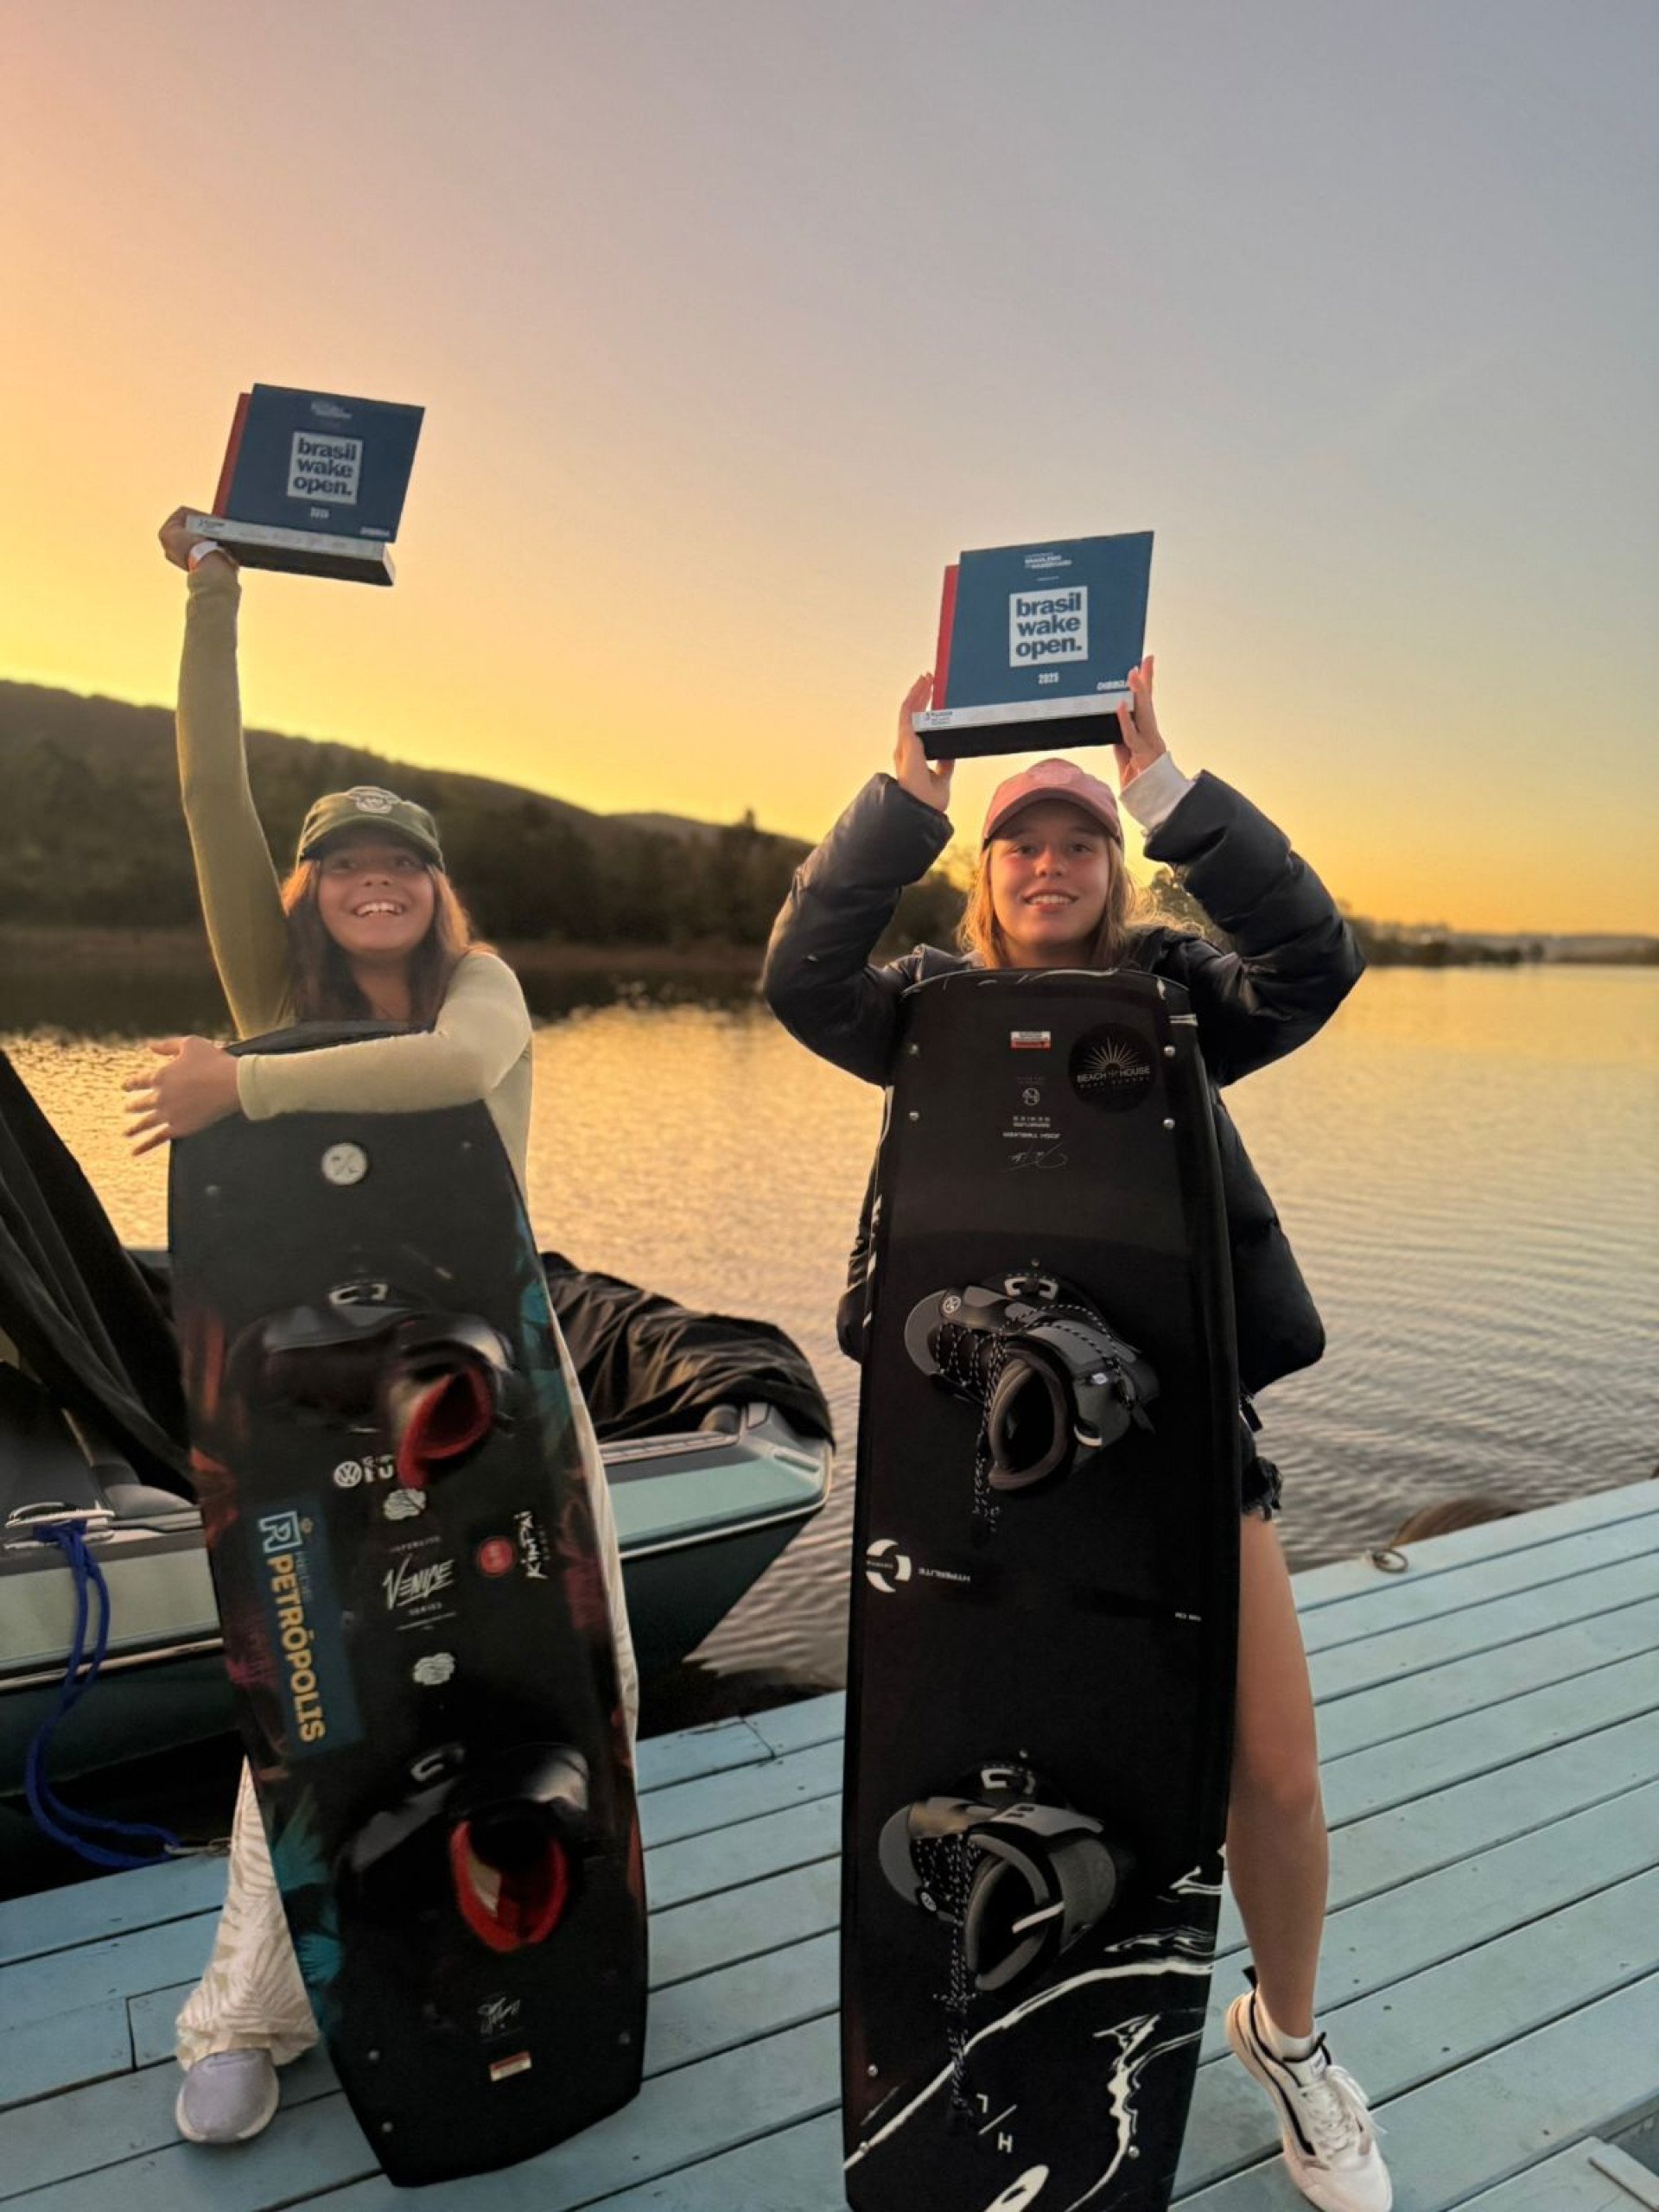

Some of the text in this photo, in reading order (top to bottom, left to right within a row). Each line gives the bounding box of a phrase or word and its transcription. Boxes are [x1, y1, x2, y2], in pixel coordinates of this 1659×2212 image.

[298, 439, 357, 461] brasil
[297, 458, 353, 480] wake
[294, 477, 352, 497] open.
[1016, 592, 1082, 618] brasil
[1017, 613, 1081, 637] wake
[1015, 637, 1082, 660] open.
[269, 1554, 325, 1742] PETRÓPOLIS
